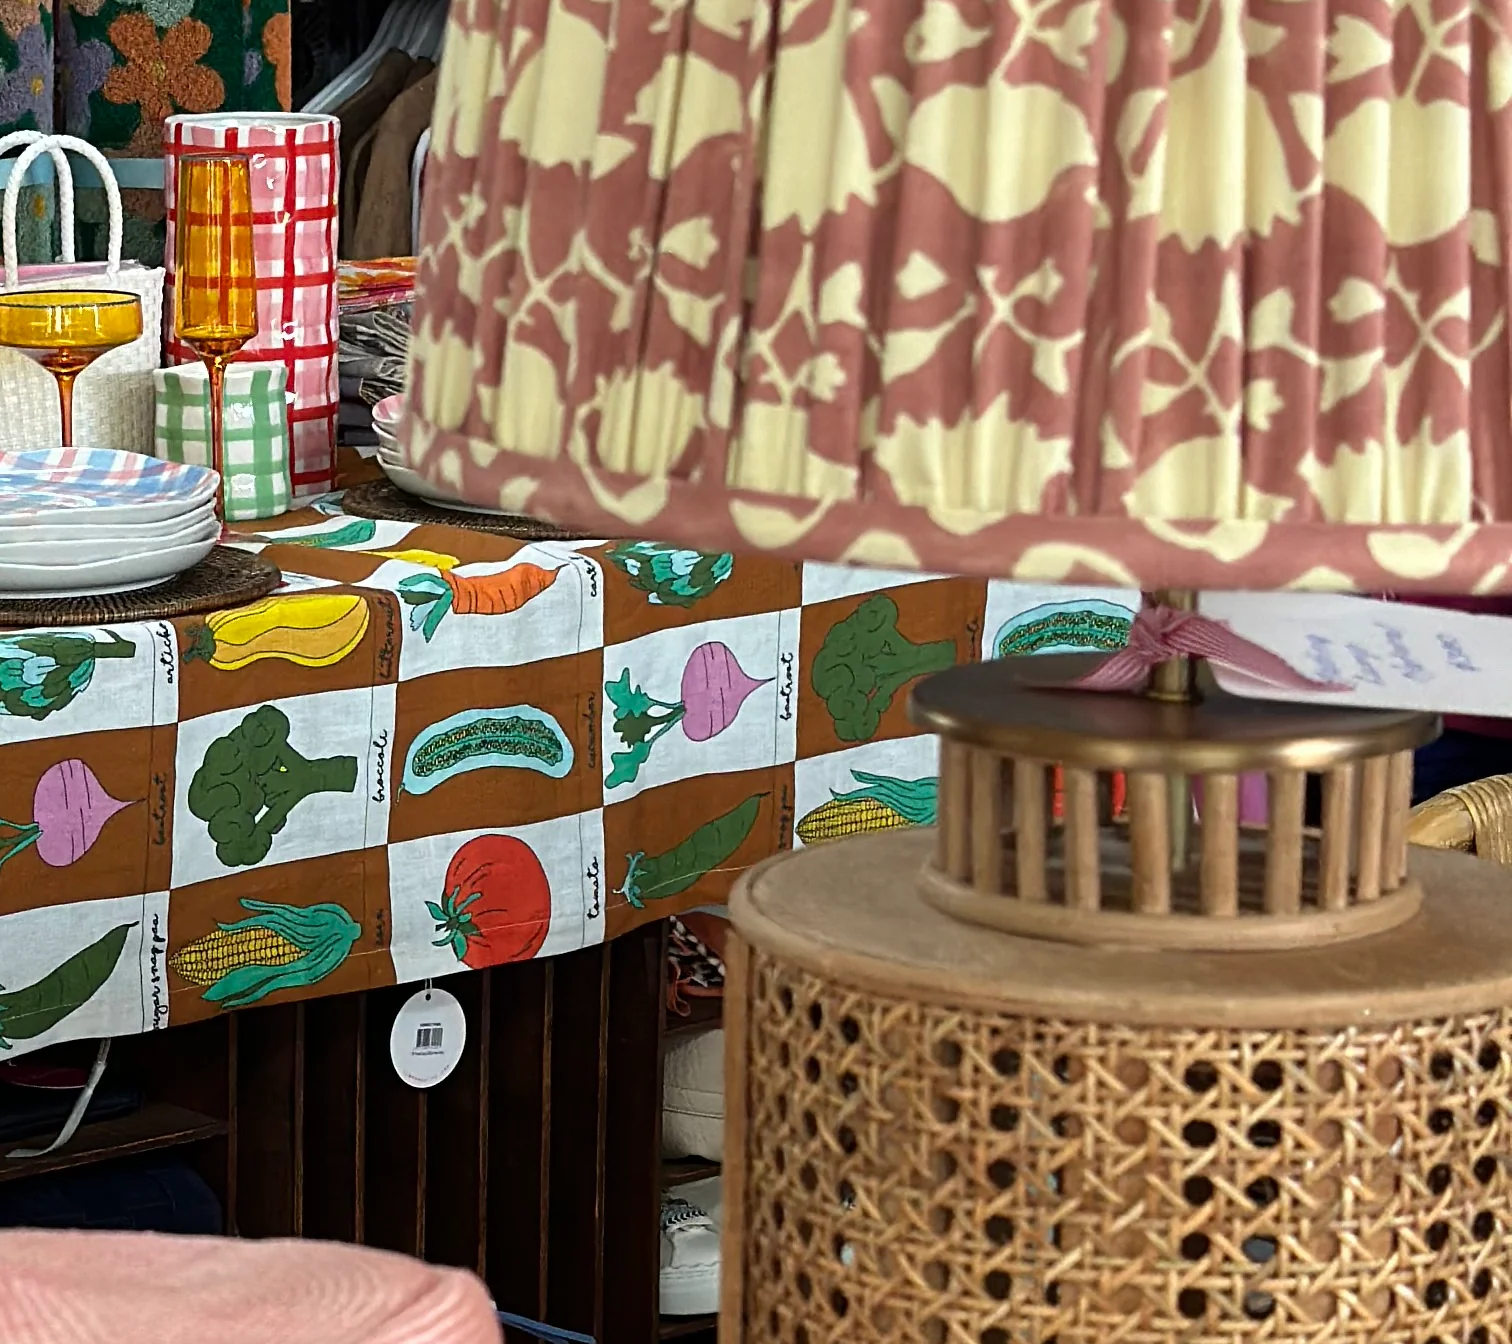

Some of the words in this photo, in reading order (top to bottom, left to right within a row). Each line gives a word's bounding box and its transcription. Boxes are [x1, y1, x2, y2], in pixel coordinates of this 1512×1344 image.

[371, 728, 388, 803] broccoli
[586, 856, 600, 920] tomato
[150, 945, 165, 983] snap
